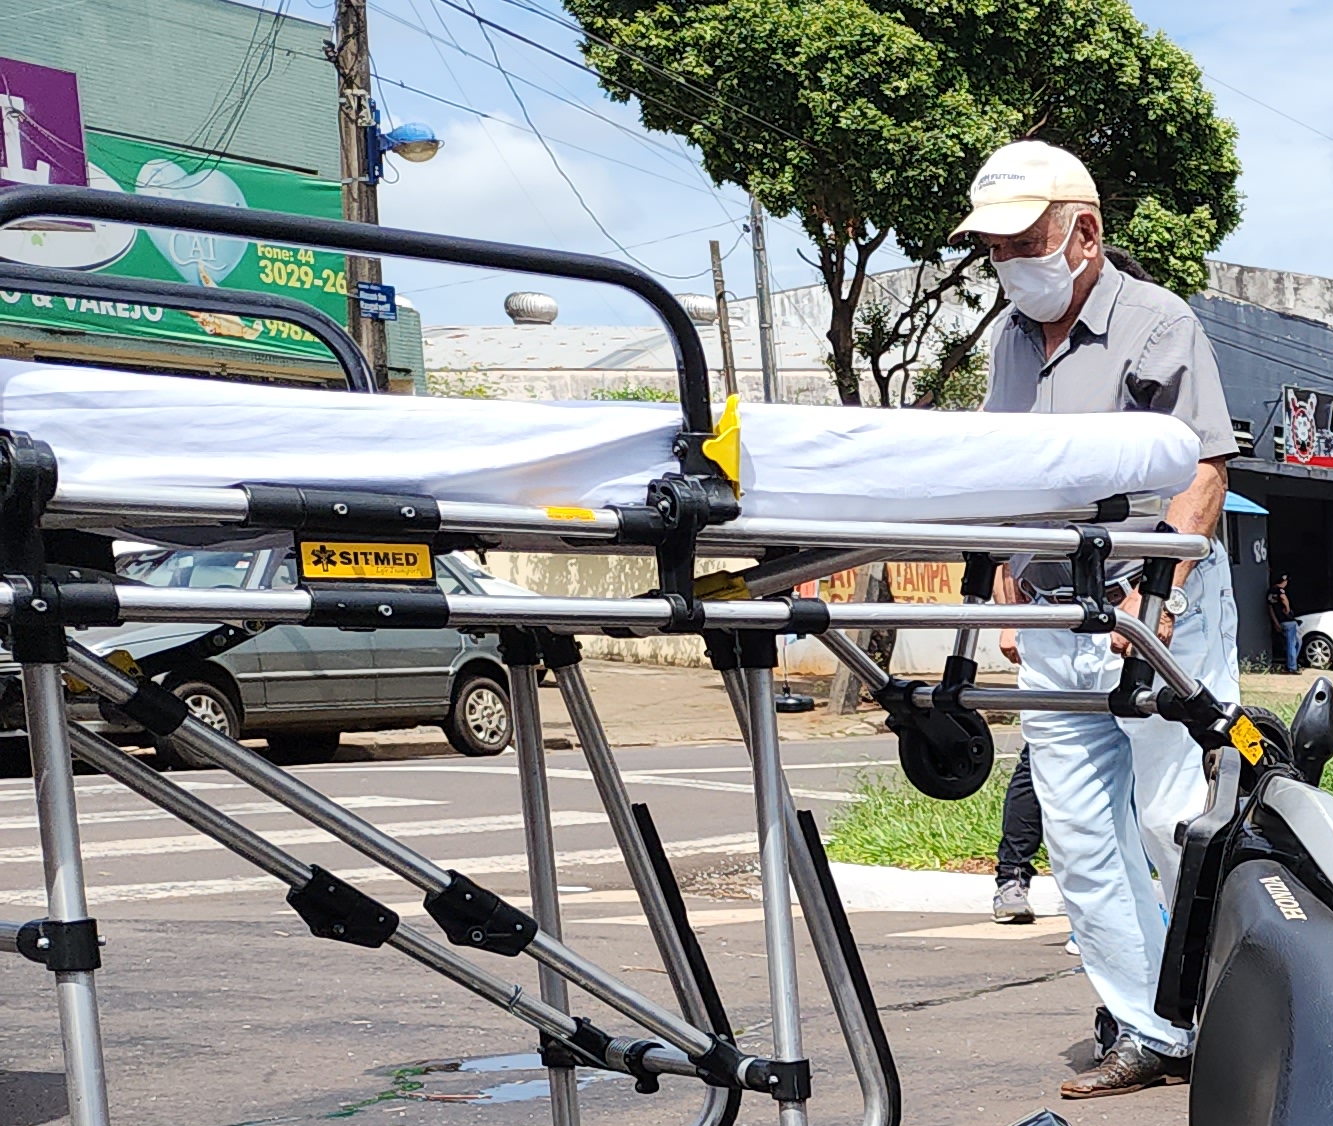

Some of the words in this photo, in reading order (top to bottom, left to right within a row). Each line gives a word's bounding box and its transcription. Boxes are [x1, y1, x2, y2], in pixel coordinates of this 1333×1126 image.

[256, 243, 295, 262] Fone:
[297, 248, 315, 265] 44
[339, 551, 418, 567] SITMED
[1258, 875, 1308, 921] HONDA
